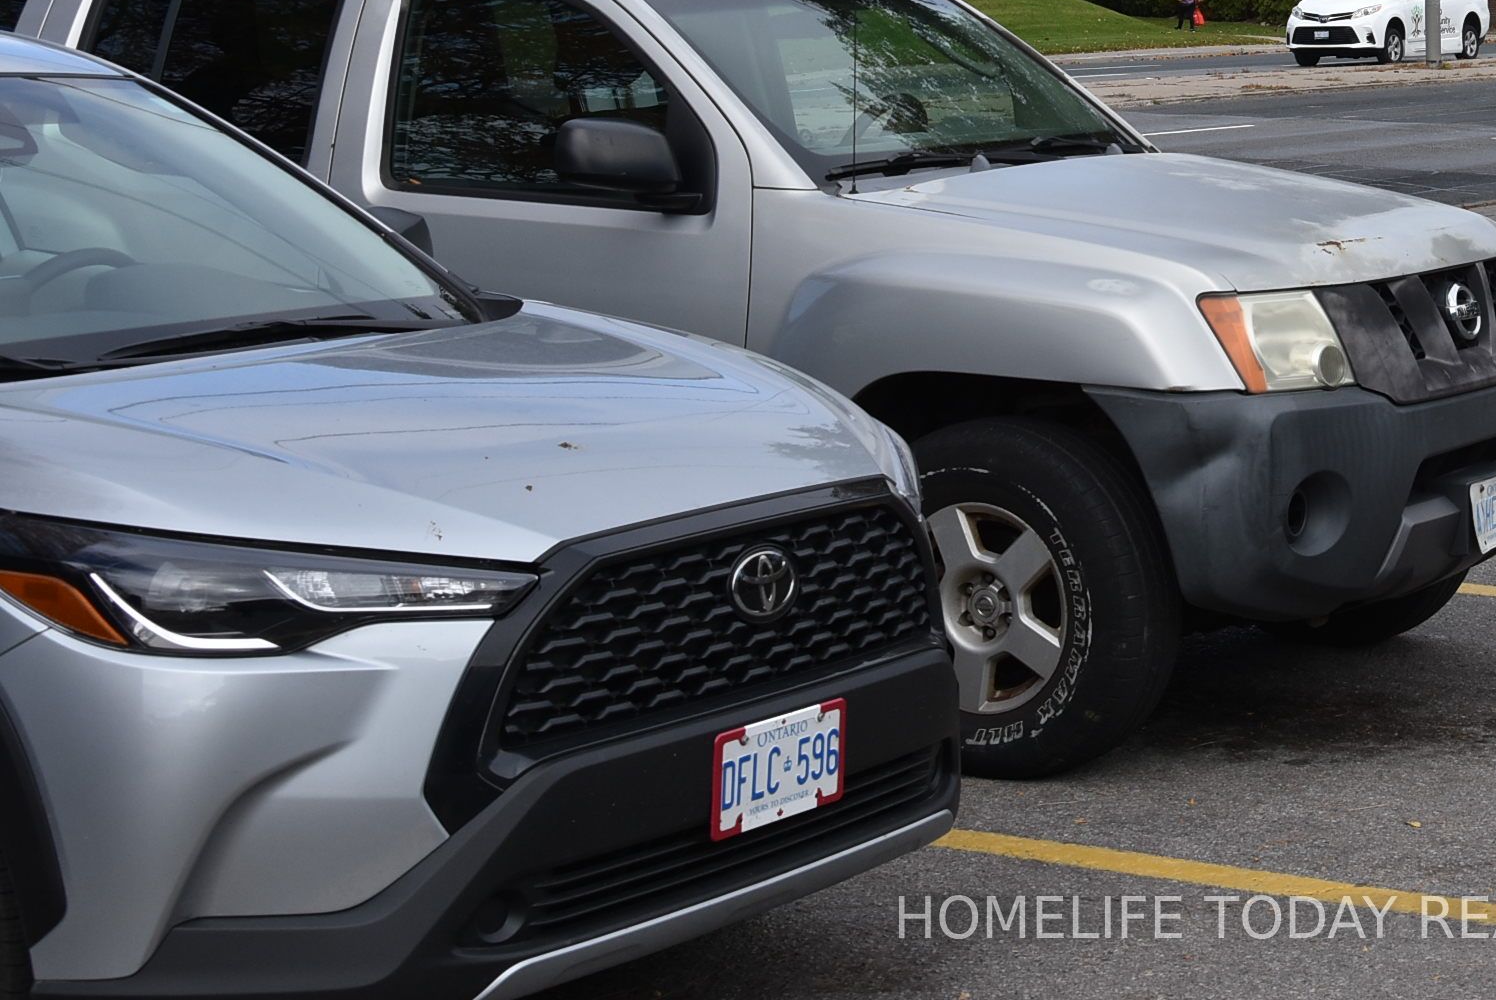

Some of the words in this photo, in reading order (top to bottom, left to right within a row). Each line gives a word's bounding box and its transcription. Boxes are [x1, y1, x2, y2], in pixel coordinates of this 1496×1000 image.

[757, 719, 809, 747] ONTARIO
[721, 746, 782, 811] DFLC
[796, 728, 839, 785] 596
